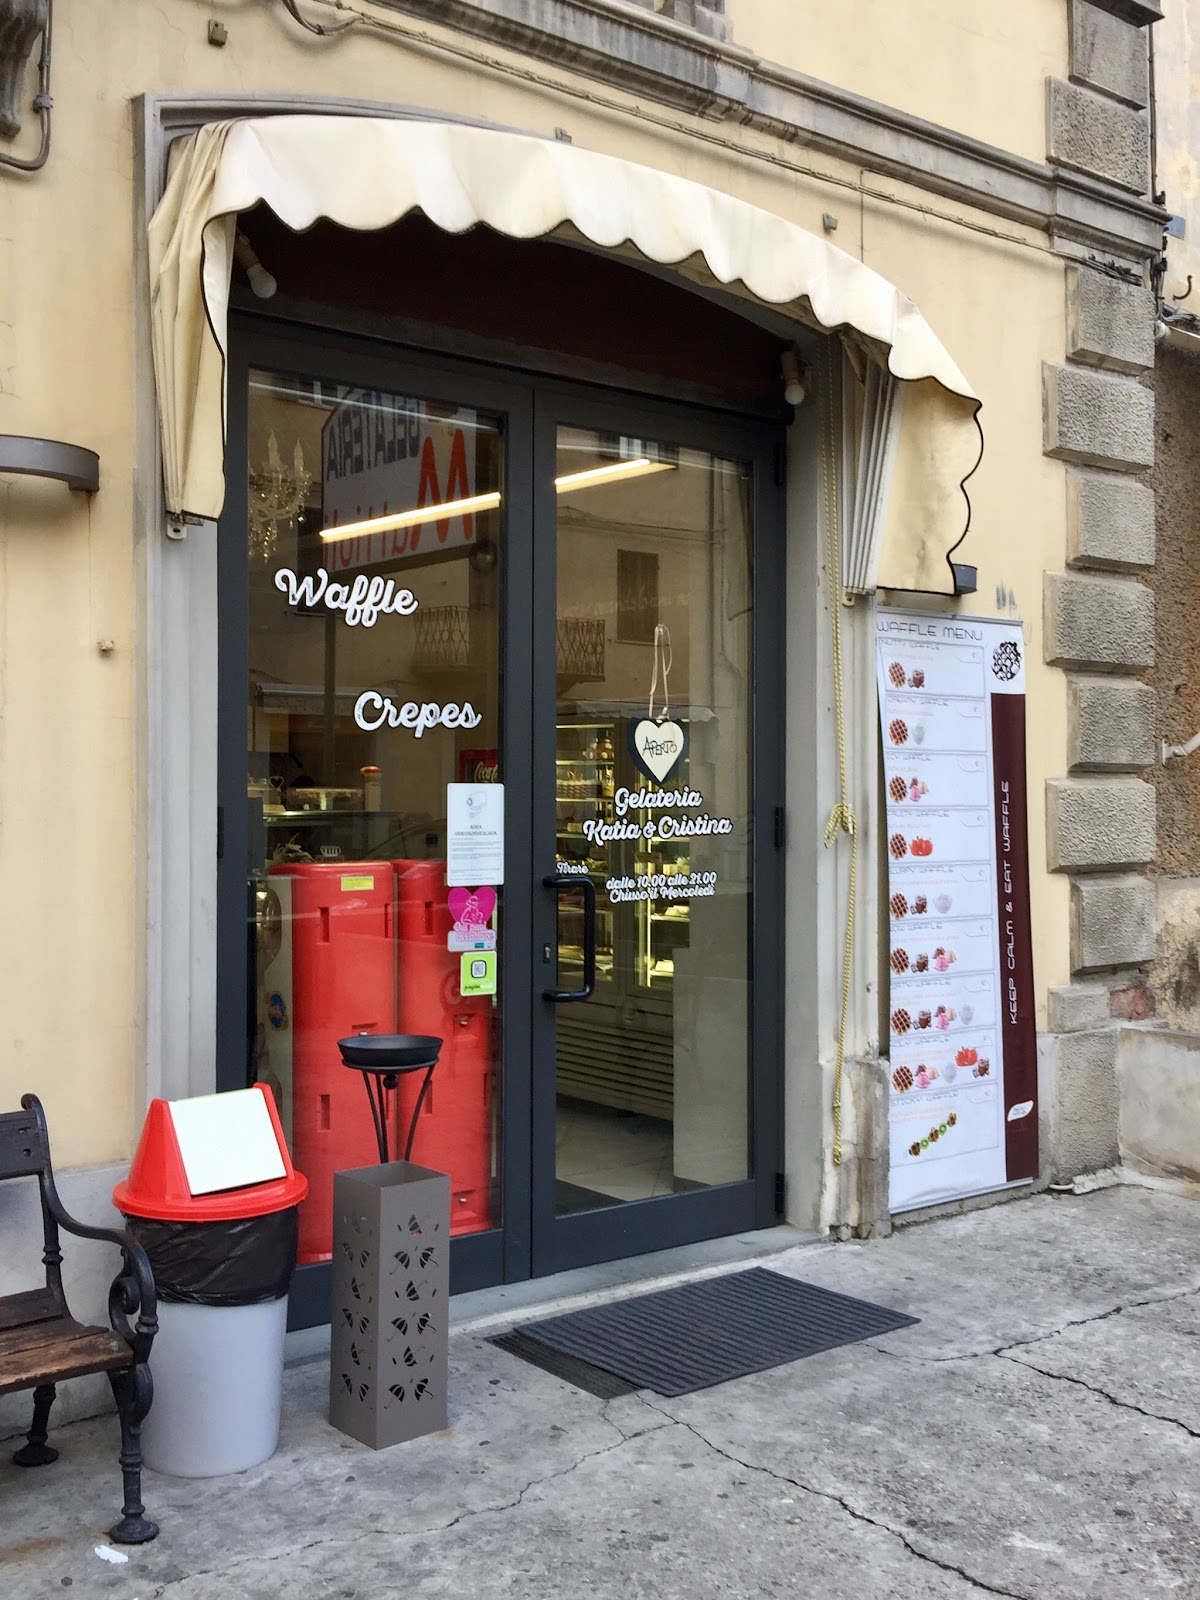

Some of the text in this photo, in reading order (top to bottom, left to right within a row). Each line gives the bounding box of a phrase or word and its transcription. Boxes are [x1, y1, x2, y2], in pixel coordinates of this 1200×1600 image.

[274, 568, 420, 628] Waffle
[876, 621, 984, 641] WAFFLE MENU
[353, 690, 483, 739] Crepes
[642, 736, 678, 759] APERTO
[614, 785, 703, 816] Gelateria
[582, 812, 733, 847] Katia & Cristina
[556, 861, 589, 875] Tirare
[606, 871, 717, 890] dalle 10.00 alle 21.00
[609, 888, 648, 904] Chiuso
[649, 889, 659, 900] il
[1001, 780, 1017, 1024] KEEP CALM & EAT WAFFLE
